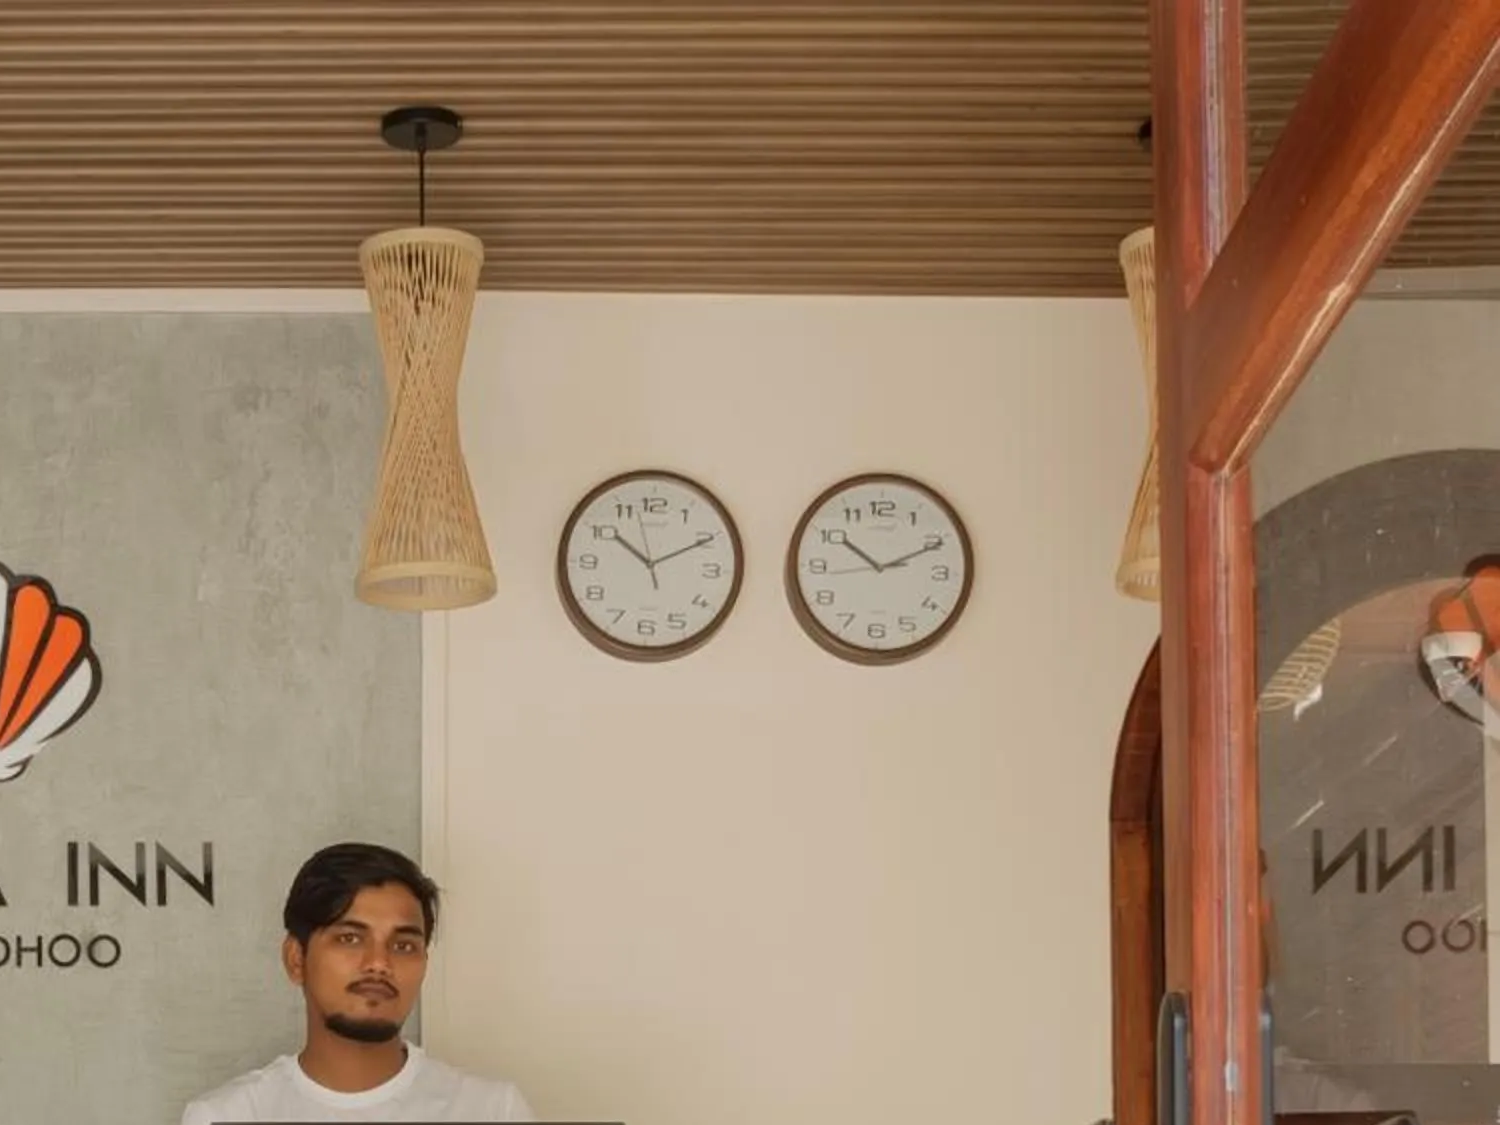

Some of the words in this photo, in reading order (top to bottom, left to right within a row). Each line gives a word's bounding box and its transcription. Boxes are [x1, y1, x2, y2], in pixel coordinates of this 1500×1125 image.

[615, 504, 632, 519] 11
[642, 498, 668, 513] 12
[869, 501, 895, 516] 12
[681, 509, 689, 524] 1
[844, 508, 860, 522] 11
[909, 511, 916, 526] 1
[592, 525, 618, 540] 10
[696, 532, 714, 548] 2
[821, 529, 847, 544] 10
[925, 535, 944, 550] 2
[579, 554, 598, 569] 9
[809, 558, 827, 574] 9
[702, 563, 720, 579] 3
[932, 566, 949, 581] 3
[586, 585, 604, 601] 8
[692, 594, 709, 607] 4
[816, 590, 834, 605] 8
[921, 596, 938, 610] 4
[606, 608, 626, 624] 7
[667, 613, 686, 629] 5
[836, 613, 856, 628] 7
[637, 620, 655, 636] 6
[868, 623, 885, 638] 6
[898, 616, 916, 632] 5
[67, 841, 214, 907] INN
